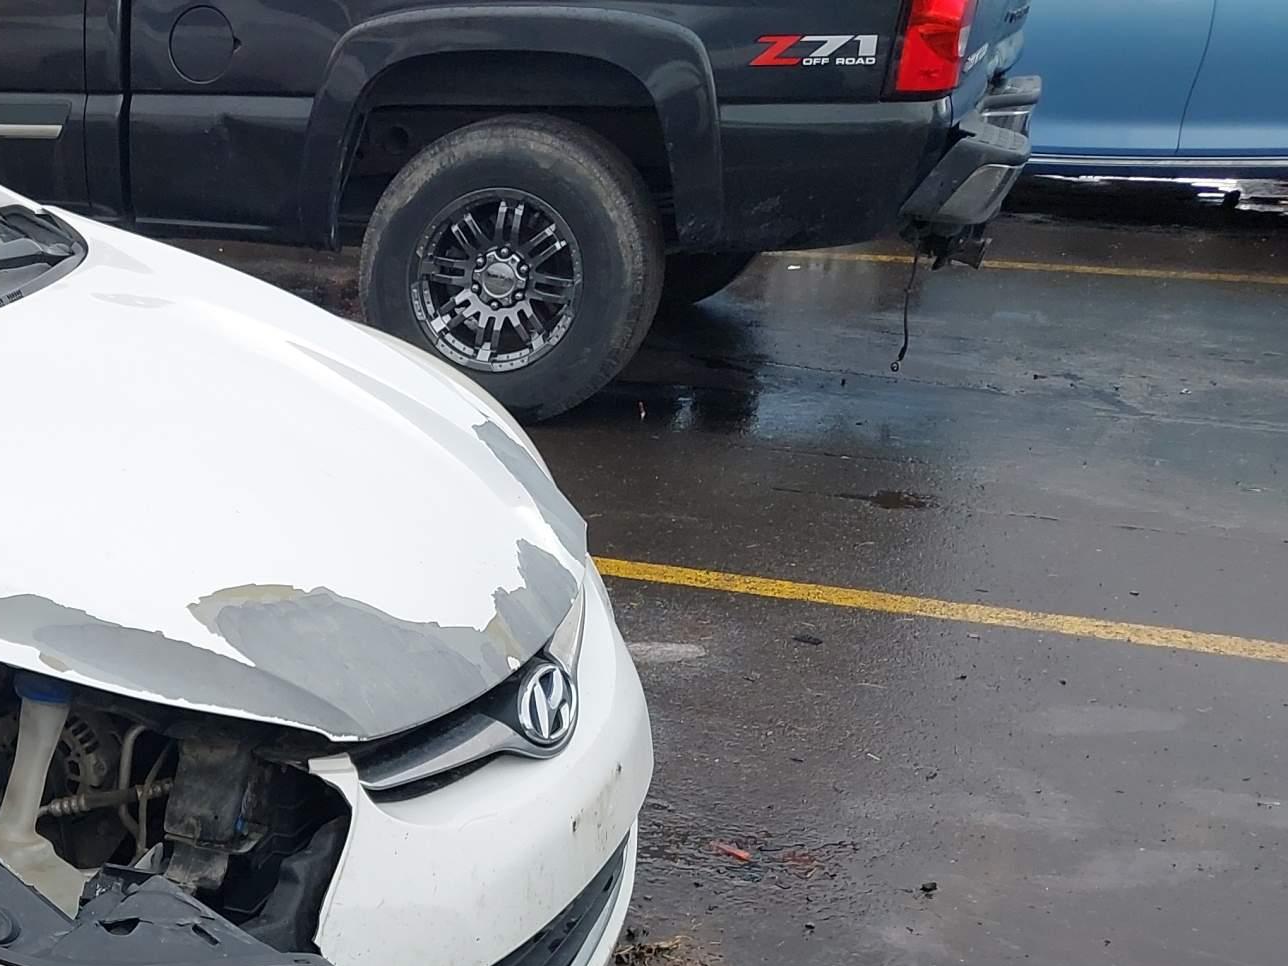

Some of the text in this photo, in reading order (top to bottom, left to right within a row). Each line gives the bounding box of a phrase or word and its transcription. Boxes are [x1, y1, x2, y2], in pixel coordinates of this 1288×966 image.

[748, 34, 878, 66] Z71
[802, 57, 876, 66] OFF ROAD
